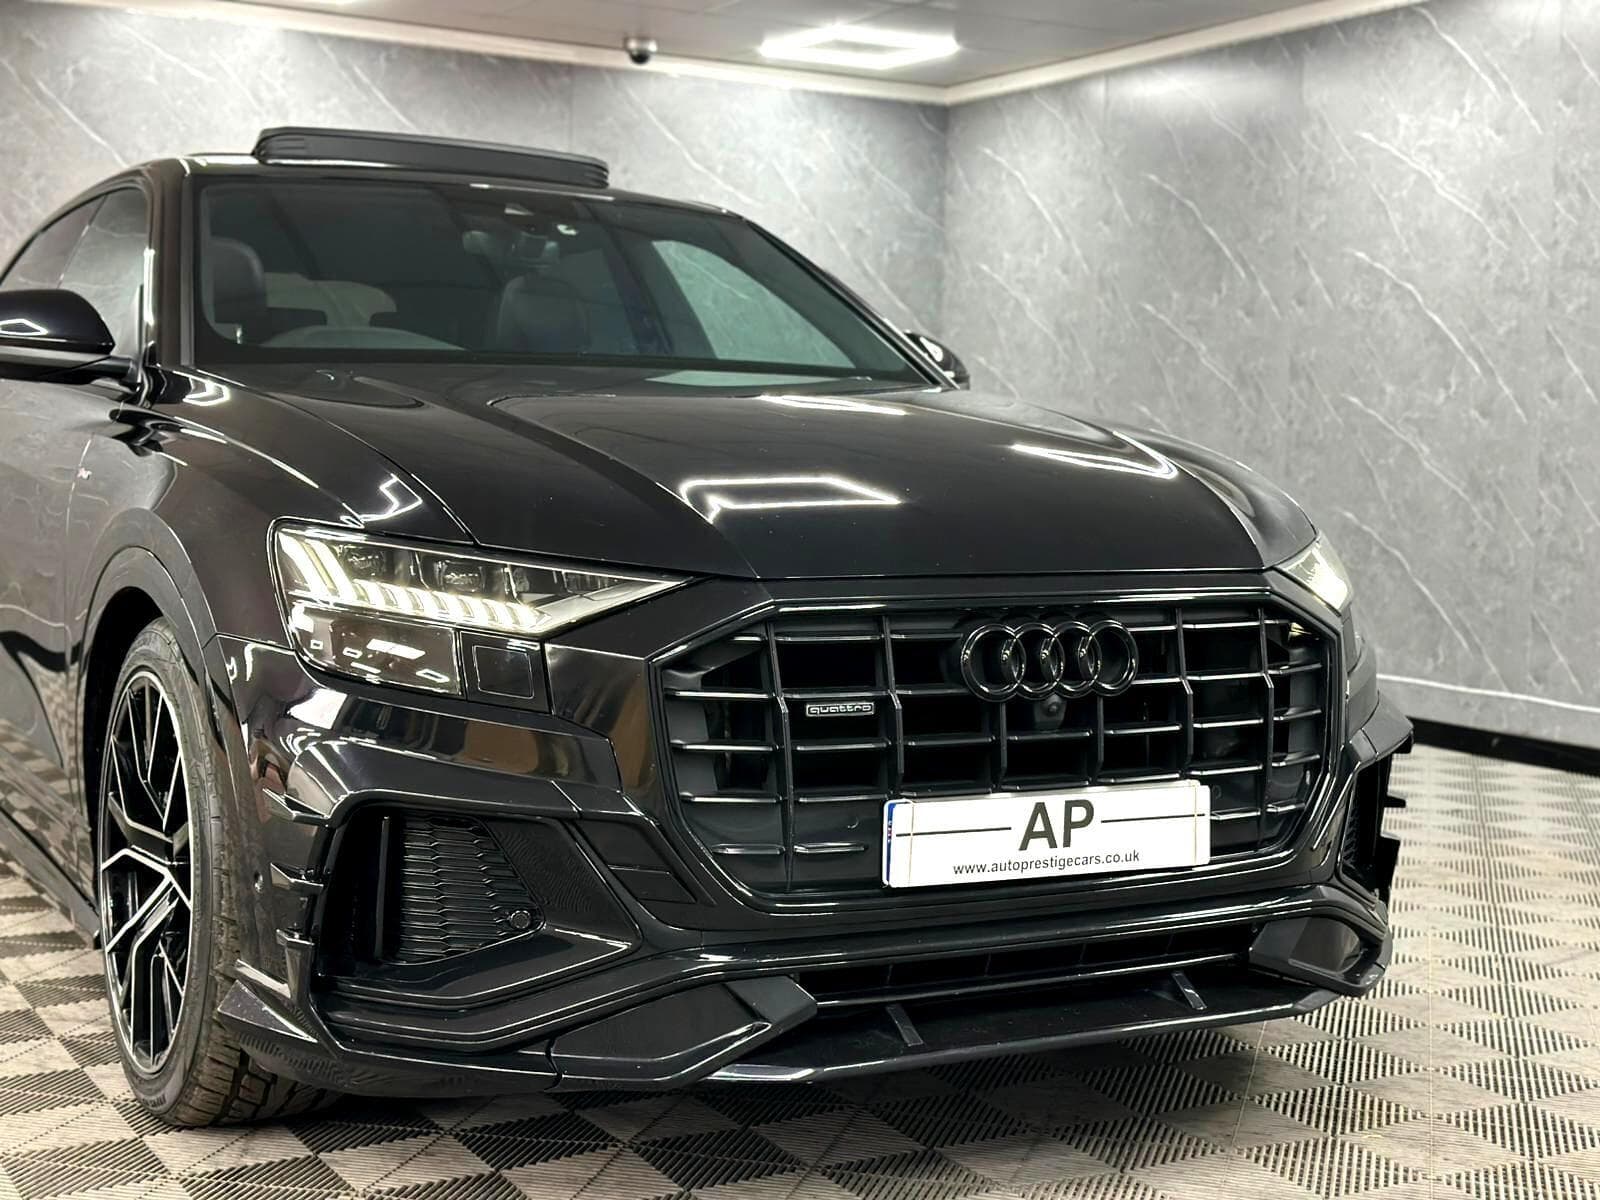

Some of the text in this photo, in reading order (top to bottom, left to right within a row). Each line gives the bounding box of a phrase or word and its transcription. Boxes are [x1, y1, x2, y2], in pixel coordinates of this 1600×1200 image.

[809, 704, 872, 715] quattro
[1018, 799, 1095, 851] AP
[953, 849, 1140, 874] www.autoprestigecars.co.uk
